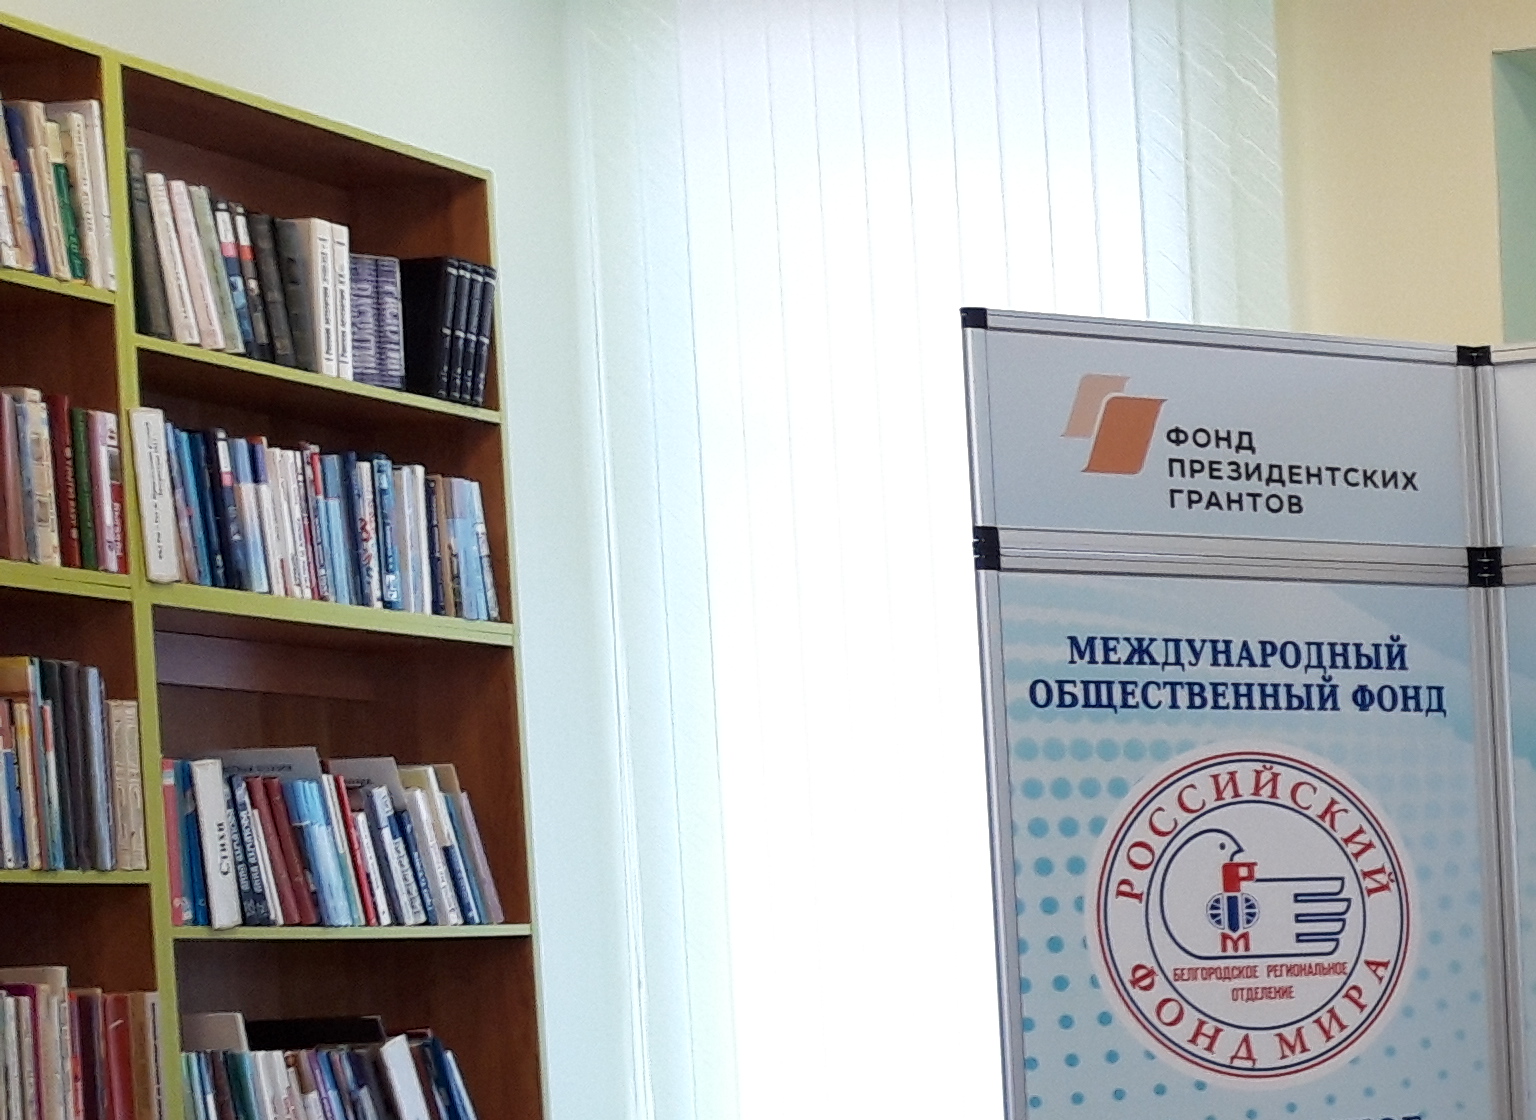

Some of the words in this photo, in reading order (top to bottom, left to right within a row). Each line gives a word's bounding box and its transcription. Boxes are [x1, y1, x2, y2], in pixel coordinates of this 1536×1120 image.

[1166, 426, 1257, 454] ФОНД
[1167, 457, 1419, 492] ПРЕЗИДЕНТСКИХ
[1168, 488, 1304, 514] ГРАНТОВ
[1066, 634, 1409, 671] МЕЖДУНАРОДНЫЙ
[1029, 675, 1341, 712] ОБЩЕСТВЕННЫЙ
[1351, 683, 1447, 717] ФОНД
[1115, 763, 1396, 903] РОССИЙСКИЙ
[1172, 965, 1259, 982] БЕЛГОРОДСКОЕ
[1266, 961, 1349, 978] РЕГИОНАЛЬНОЕ
[1231, 985, 1295, 1002] ОТДЕЛЕНИЕ
[1129, 963, 1258, 1067] ФОНД
[1275, 956, 1390, 1060] МИРА
